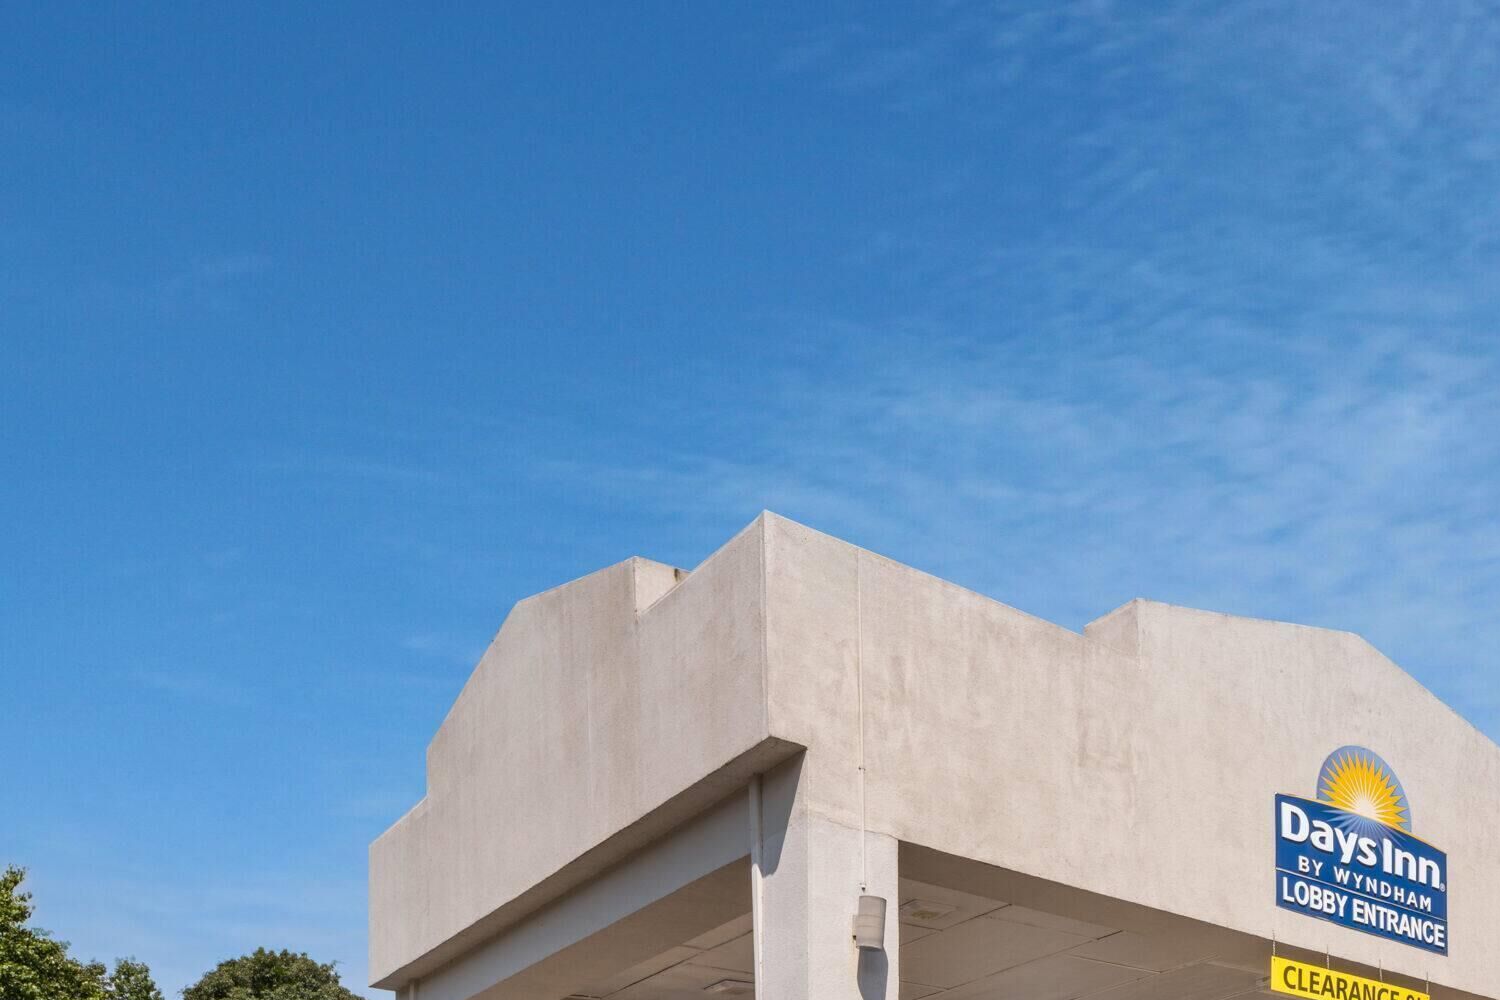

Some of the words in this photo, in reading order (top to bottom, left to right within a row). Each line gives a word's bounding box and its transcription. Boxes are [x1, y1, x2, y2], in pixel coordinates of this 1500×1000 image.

[1280, 802, 1377, 867] Days
[1383, 837, 1441, 888] Inn
[1282, 877, 1348, 918] LOBBY
[1352, 900, 1445, 948] ENTRANCE
[1298, 855, 1323, 876] BY
[1334, 866, 1432, 912] WYNDHAM
